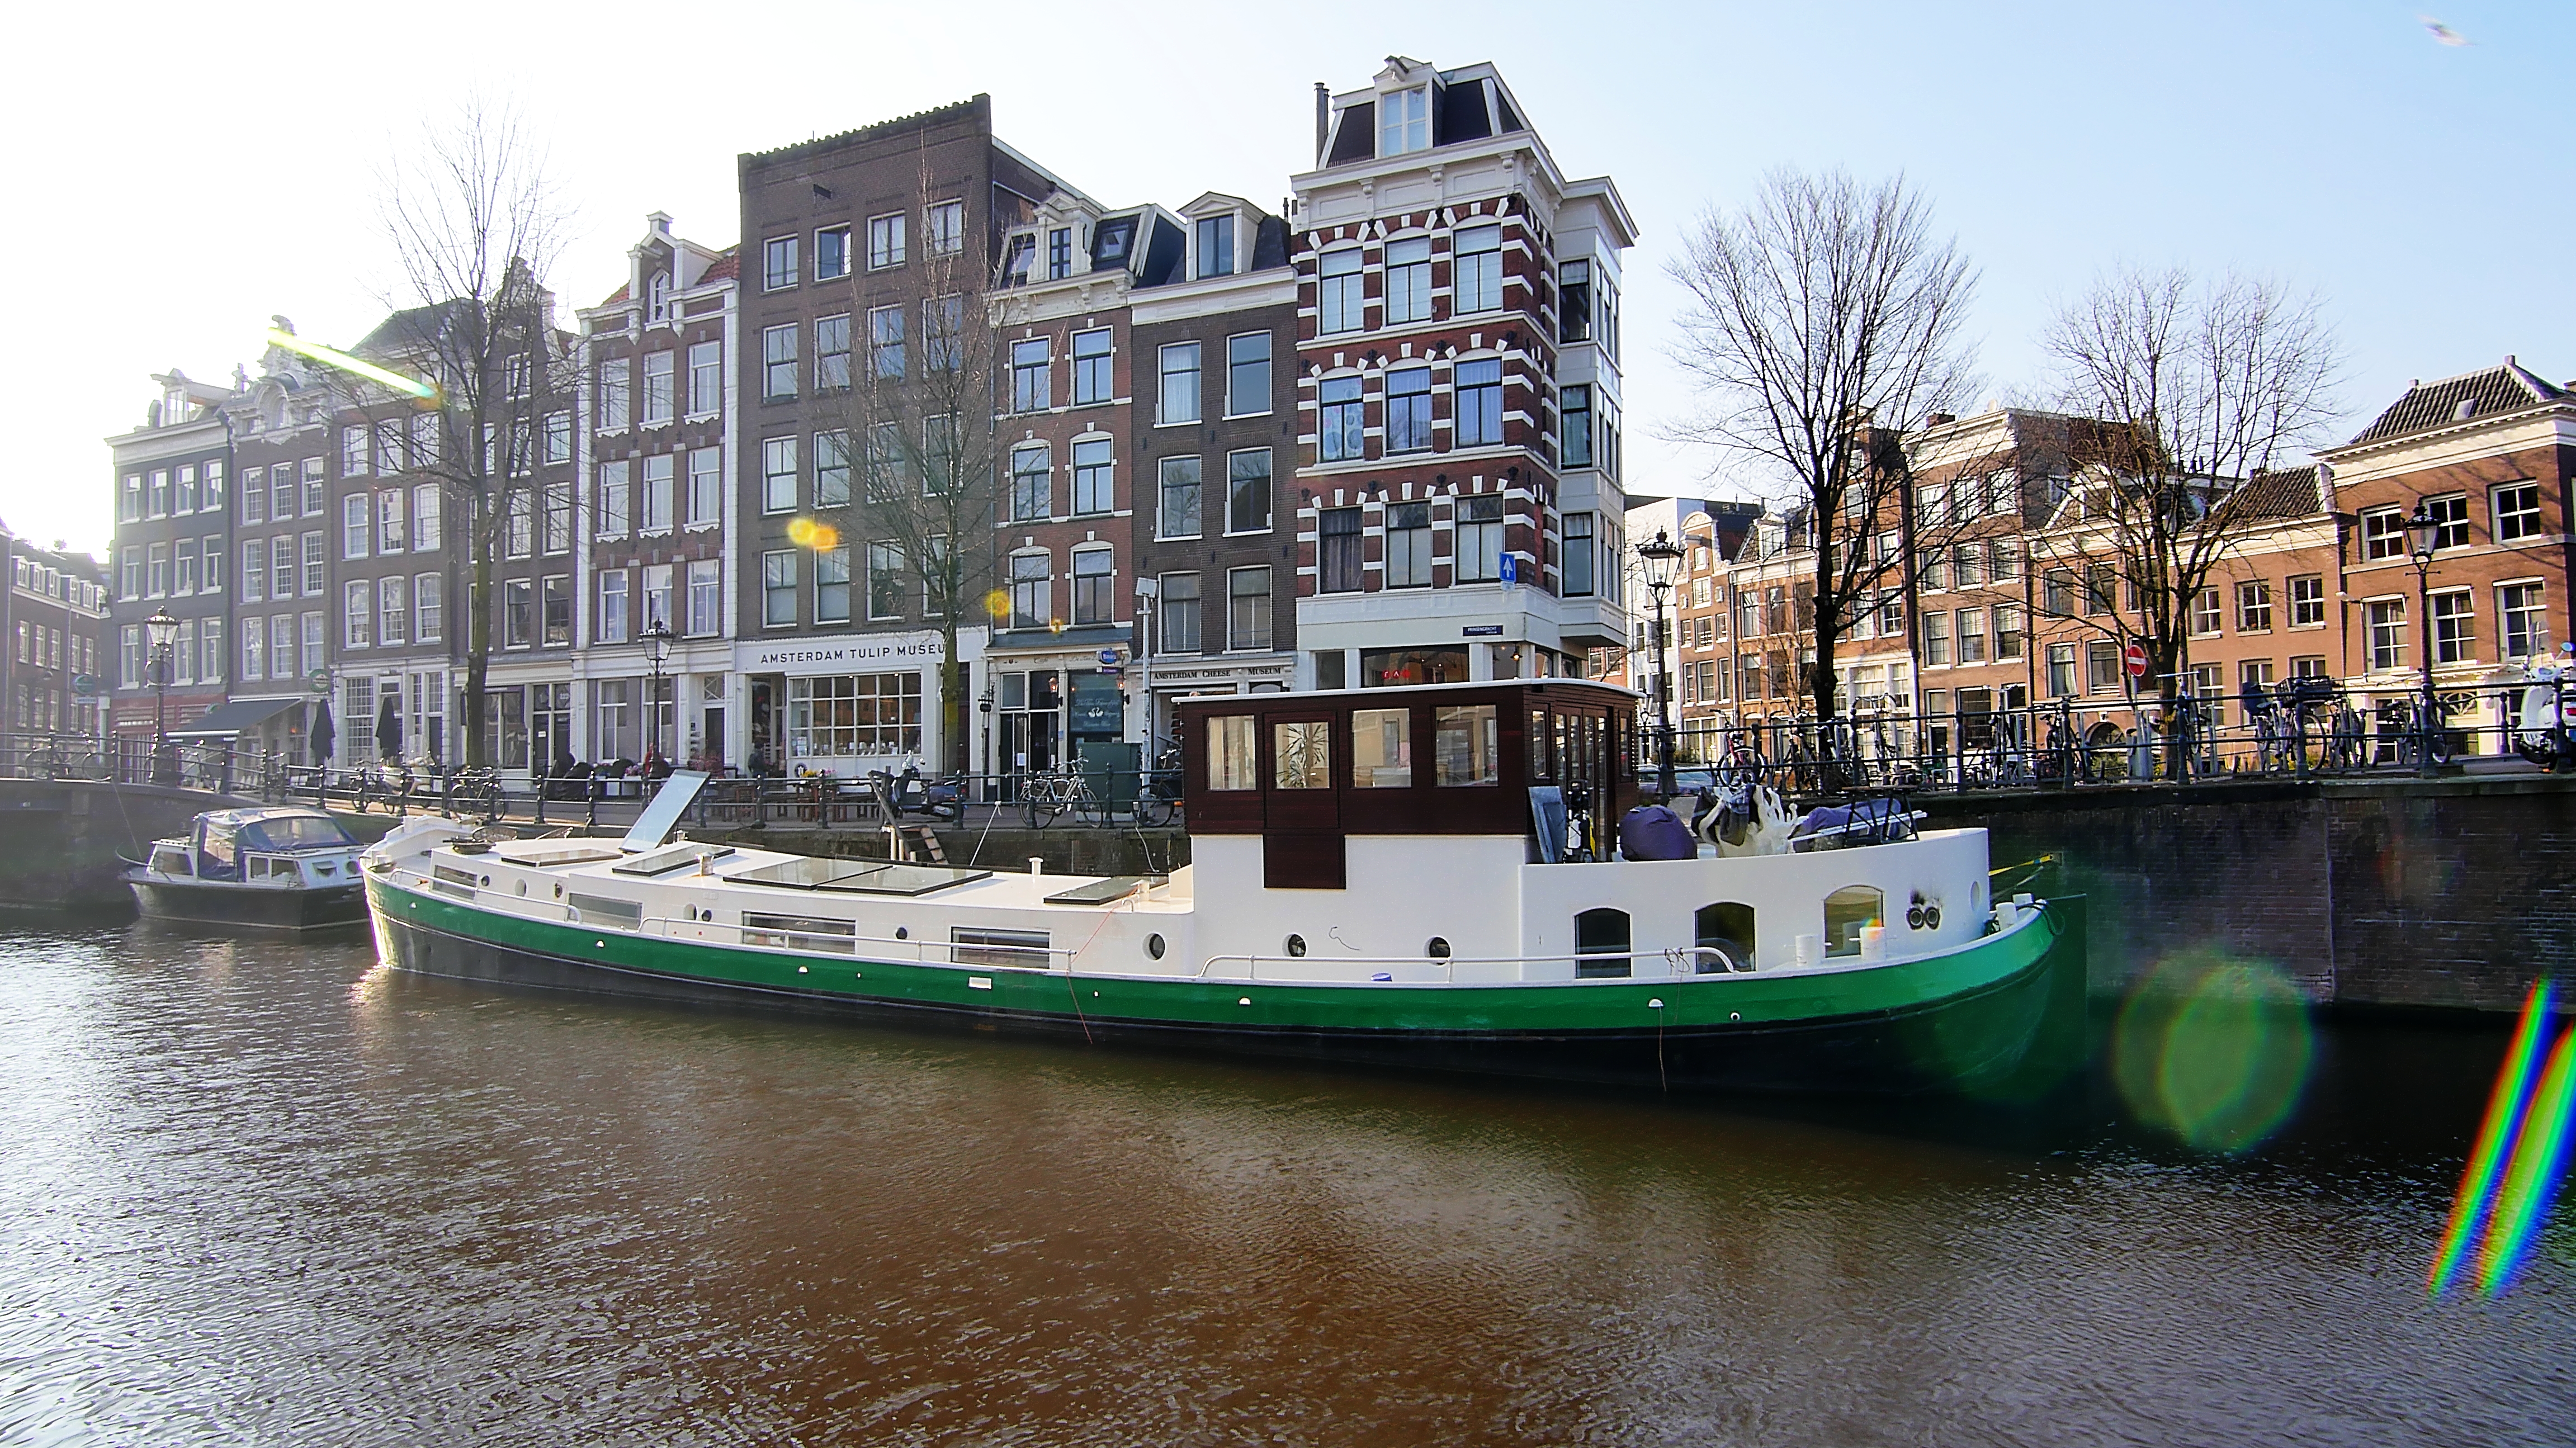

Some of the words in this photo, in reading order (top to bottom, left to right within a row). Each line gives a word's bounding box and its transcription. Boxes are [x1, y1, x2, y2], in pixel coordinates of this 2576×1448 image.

[761, 650, 843, 664] AMSTERDAM
[850, 647, 890, 659] TULIP
[897, 644, 945, 656] MUSEU
[1154, 671, 1197, 680] AMSTERDAM
